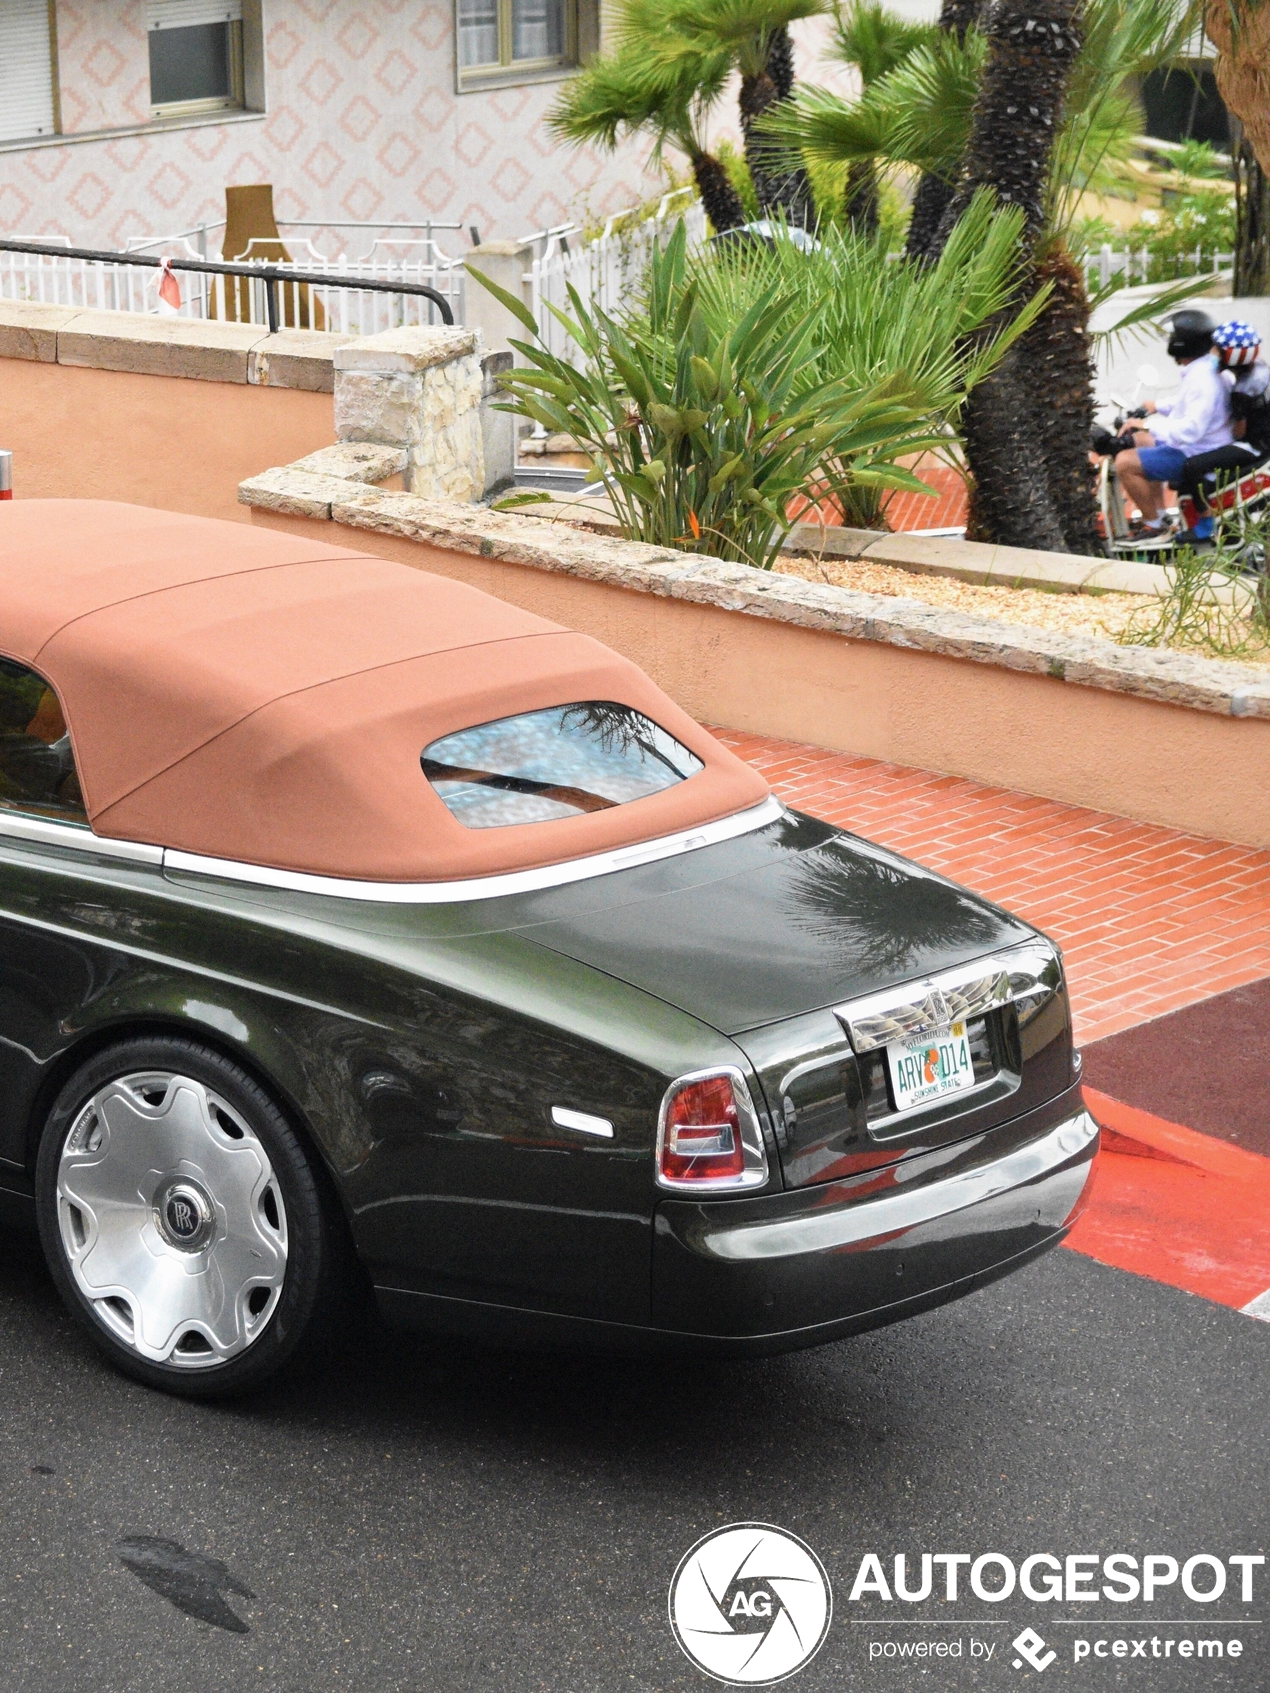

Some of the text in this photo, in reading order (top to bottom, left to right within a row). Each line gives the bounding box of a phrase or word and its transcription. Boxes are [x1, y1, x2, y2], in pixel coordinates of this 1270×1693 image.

[914, 1077, 958, 1101] SUNSHINE STATE
[172, 1201, 193, 1230] RR
